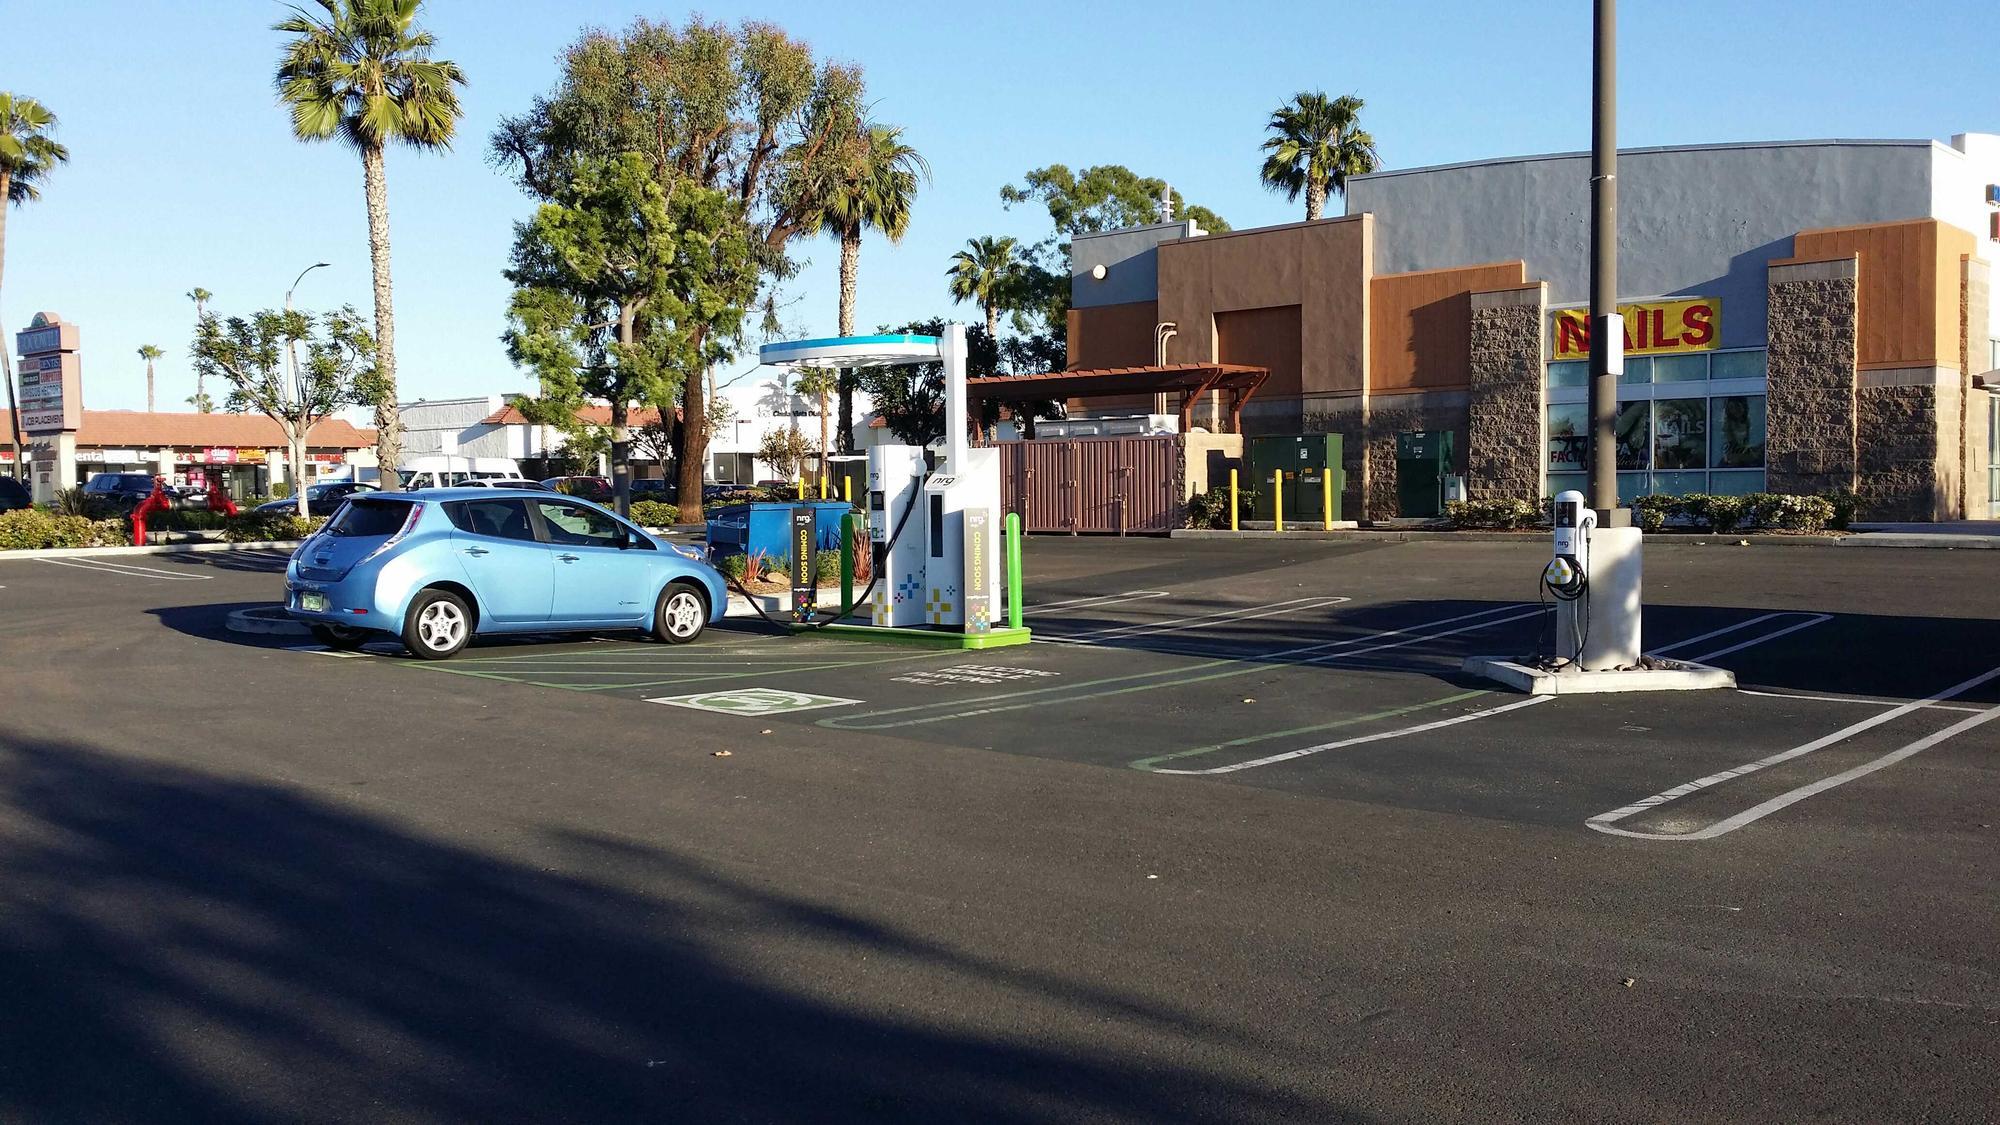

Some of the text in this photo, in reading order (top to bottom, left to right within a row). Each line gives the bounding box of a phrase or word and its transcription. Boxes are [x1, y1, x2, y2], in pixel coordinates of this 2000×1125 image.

[1560, 305, 1714, 353] NILS
[932, 477, 955, 486] nrg
[800, 529, 808, 560] COMING
[974, 531, 982, 565] COMING
[1557, 541, 1569, 549] nrg
[801, 561, 809, 584] SOON
[974, 565, 982, 591] SOON
